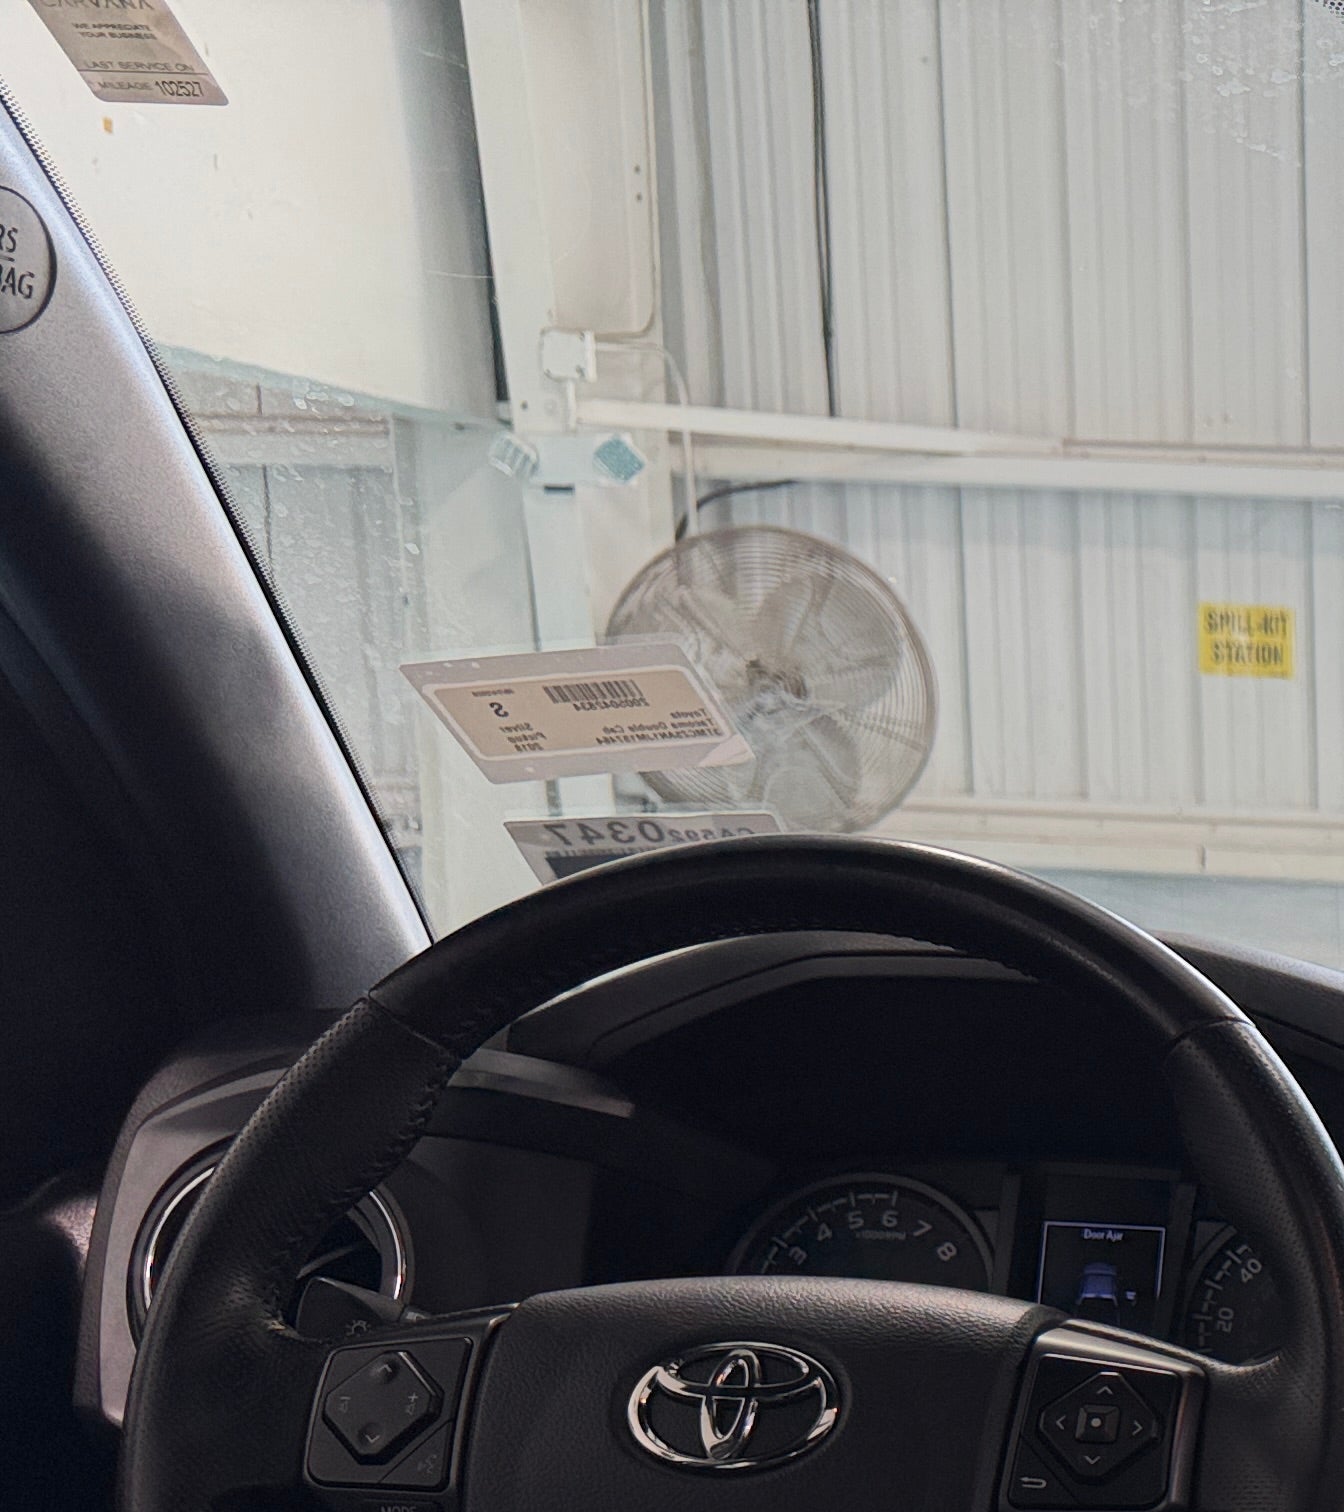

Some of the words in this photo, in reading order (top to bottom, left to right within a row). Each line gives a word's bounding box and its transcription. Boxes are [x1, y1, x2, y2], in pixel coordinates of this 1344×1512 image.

[84, 61, 114, 69] LAST
[118, 61, 174, 71] SERVICE
[175, 63, 196, 72] ON
[97, 81, 153, 91] MILEAGE
[154, 80, 205, 97] 102527
[0, 263, 35, 299] AG
[1213, 640, 1284, 665] STATION
[848, 1210, 865, 1230] 5
[881, 1210, 898, 1228] 6
[913, 1219, 933, 1237] 7
[817, 1222, 833, 1242] 4
[1083, 1228, 1105, 1240] Door
[1106, 1229, 1124, 1242] Ajar
[788, 1246, 808, 1266] 3
[936, 1241, 958, 1262] 8
[1240, 1258, 1263, 1283] 40
[1217, 1306, 1235, 1333] 20
